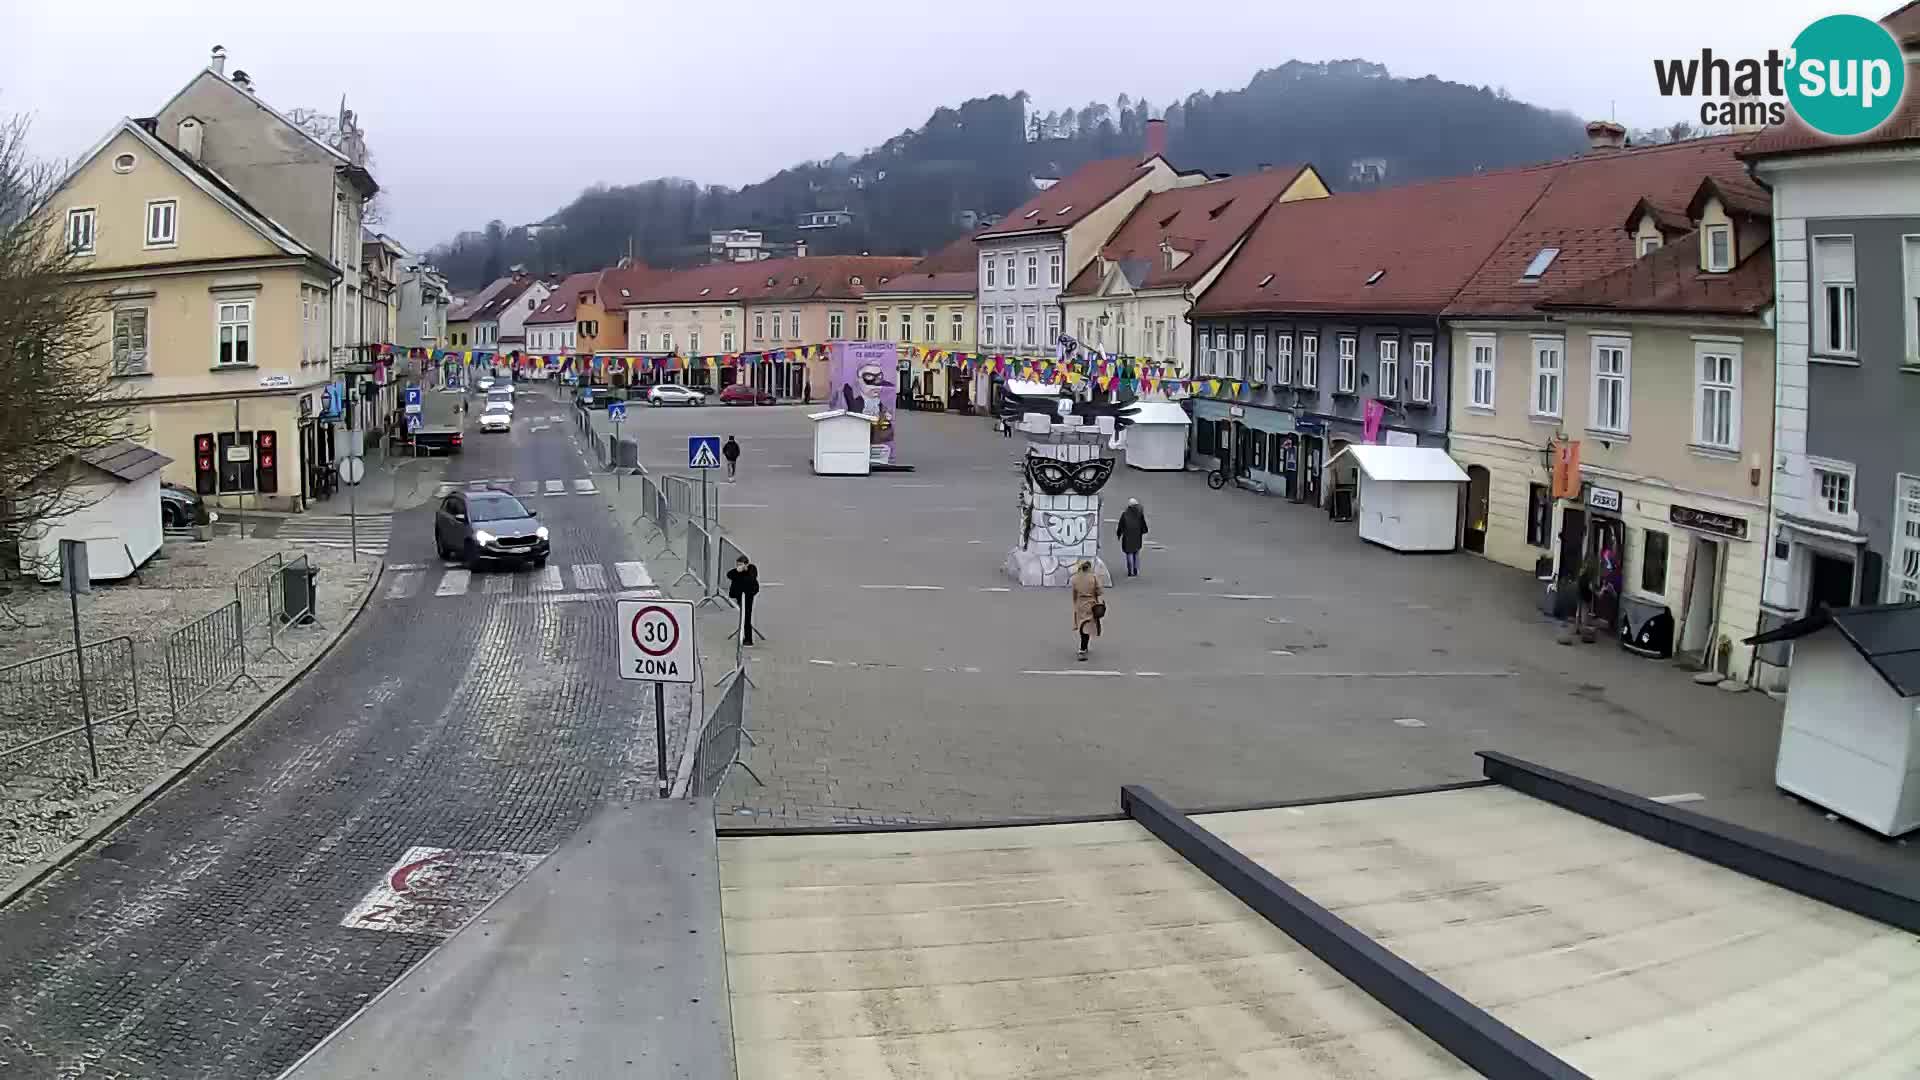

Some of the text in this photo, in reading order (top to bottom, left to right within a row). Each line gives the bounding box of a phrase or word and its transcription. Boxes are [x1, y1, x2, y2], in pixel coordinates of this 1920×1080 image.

[409, 391, 417, 403] P
[1048, 516, 1088, 545] 200
[644, 621, 668, 643] 30
[635, 659, 679, 676] ZONA
